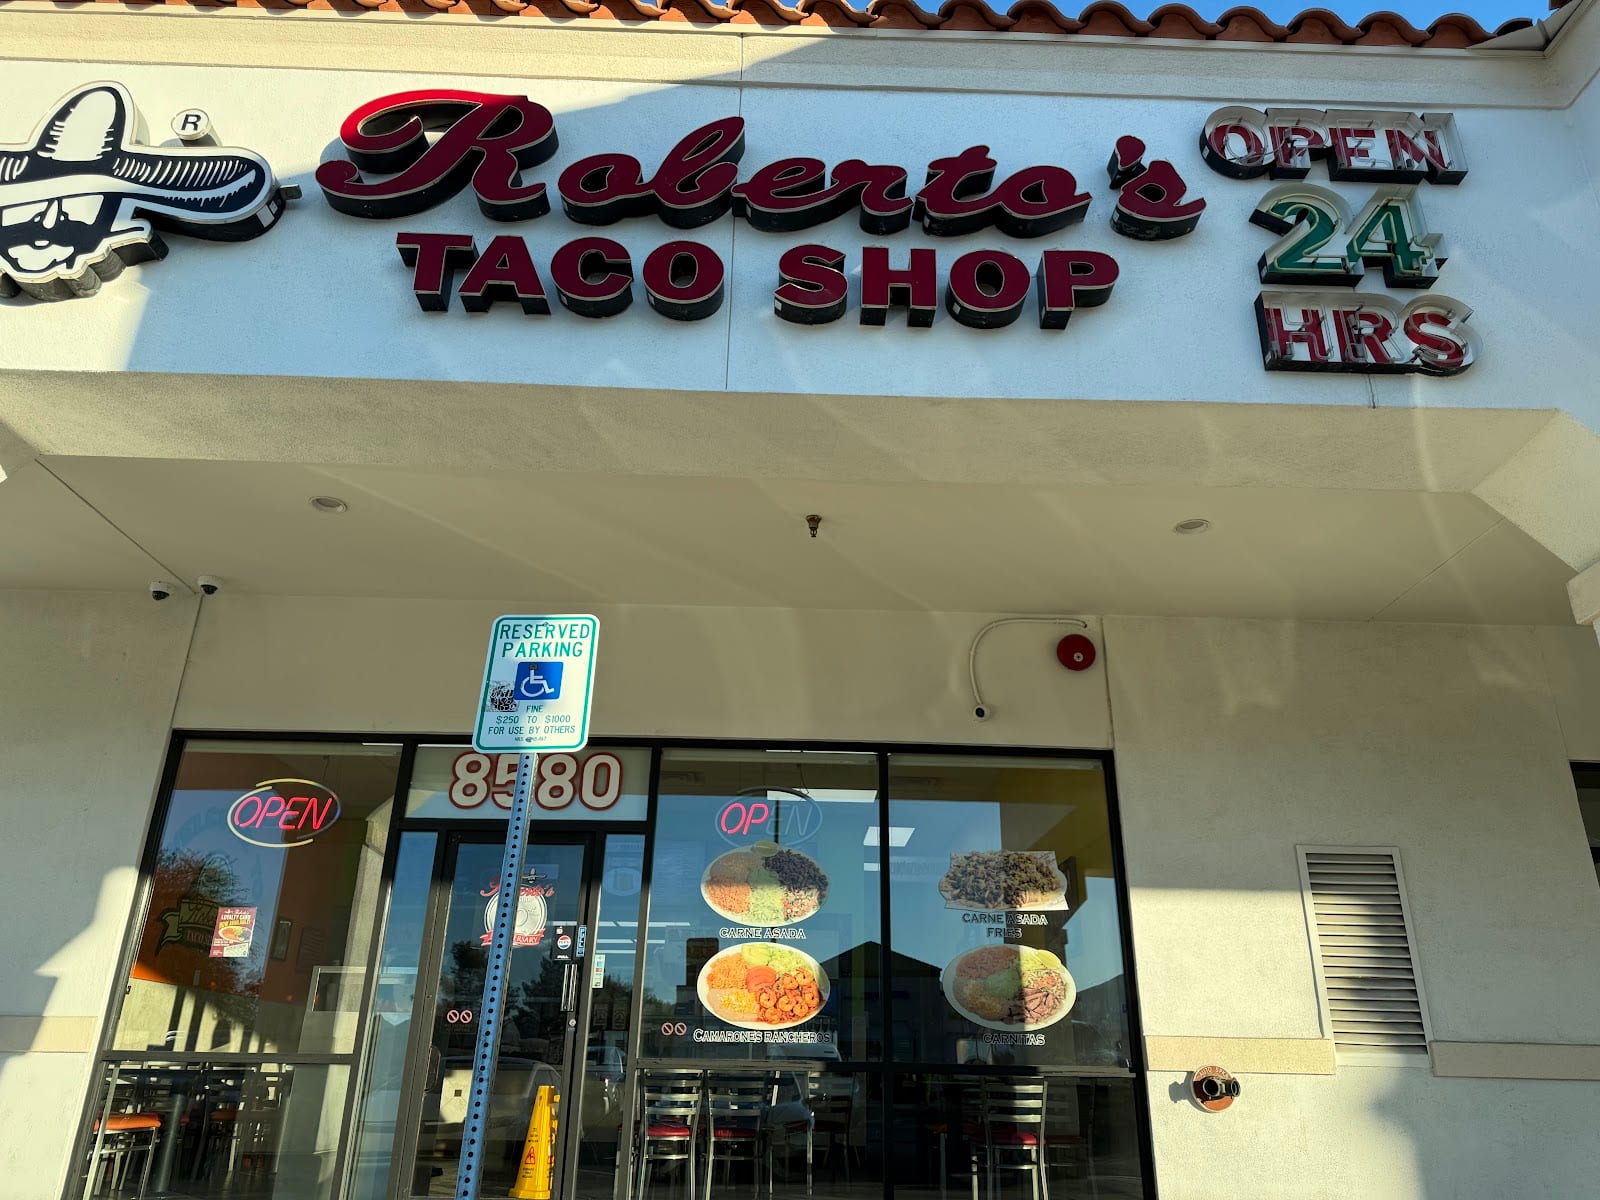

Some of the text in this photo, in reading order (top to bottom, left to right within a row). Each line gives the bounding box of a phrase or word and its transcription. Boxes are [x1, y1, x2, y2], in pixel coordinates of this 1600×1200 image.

[1201, 106, 1468, 185] OPEN
[315, 89, 1205, 235] Roberto's
[1249, 183, 1448, 289] 24
[396, 232, 1119, 329] TACO SHOP
[1254, 291, 1483, 377] HRS
[500, 623, 590, 639] RESERVED
[502, 642, 583, 657] PARKING
[526, 704, 544, 713] FINE
[496, 715, 571, 724] $250 TO $1000
[488, 725, 576, 735] FOR USE BY OTHERS
[449, 752, 623, 811] 8580
[234, 796, 332, 830] OPEN
[721, 803, 813, 835] OPEN
[962, 913, 1048, 925] CARNE ASADA
[719, 927, 806, 939] CARNE ASADA
[986, 927, 1022, 938] FRIES
[693, 1029, 832, 1043] CAMARONES RANCHEROS
[983, 1034, 1045, 1046] CARNITAS
